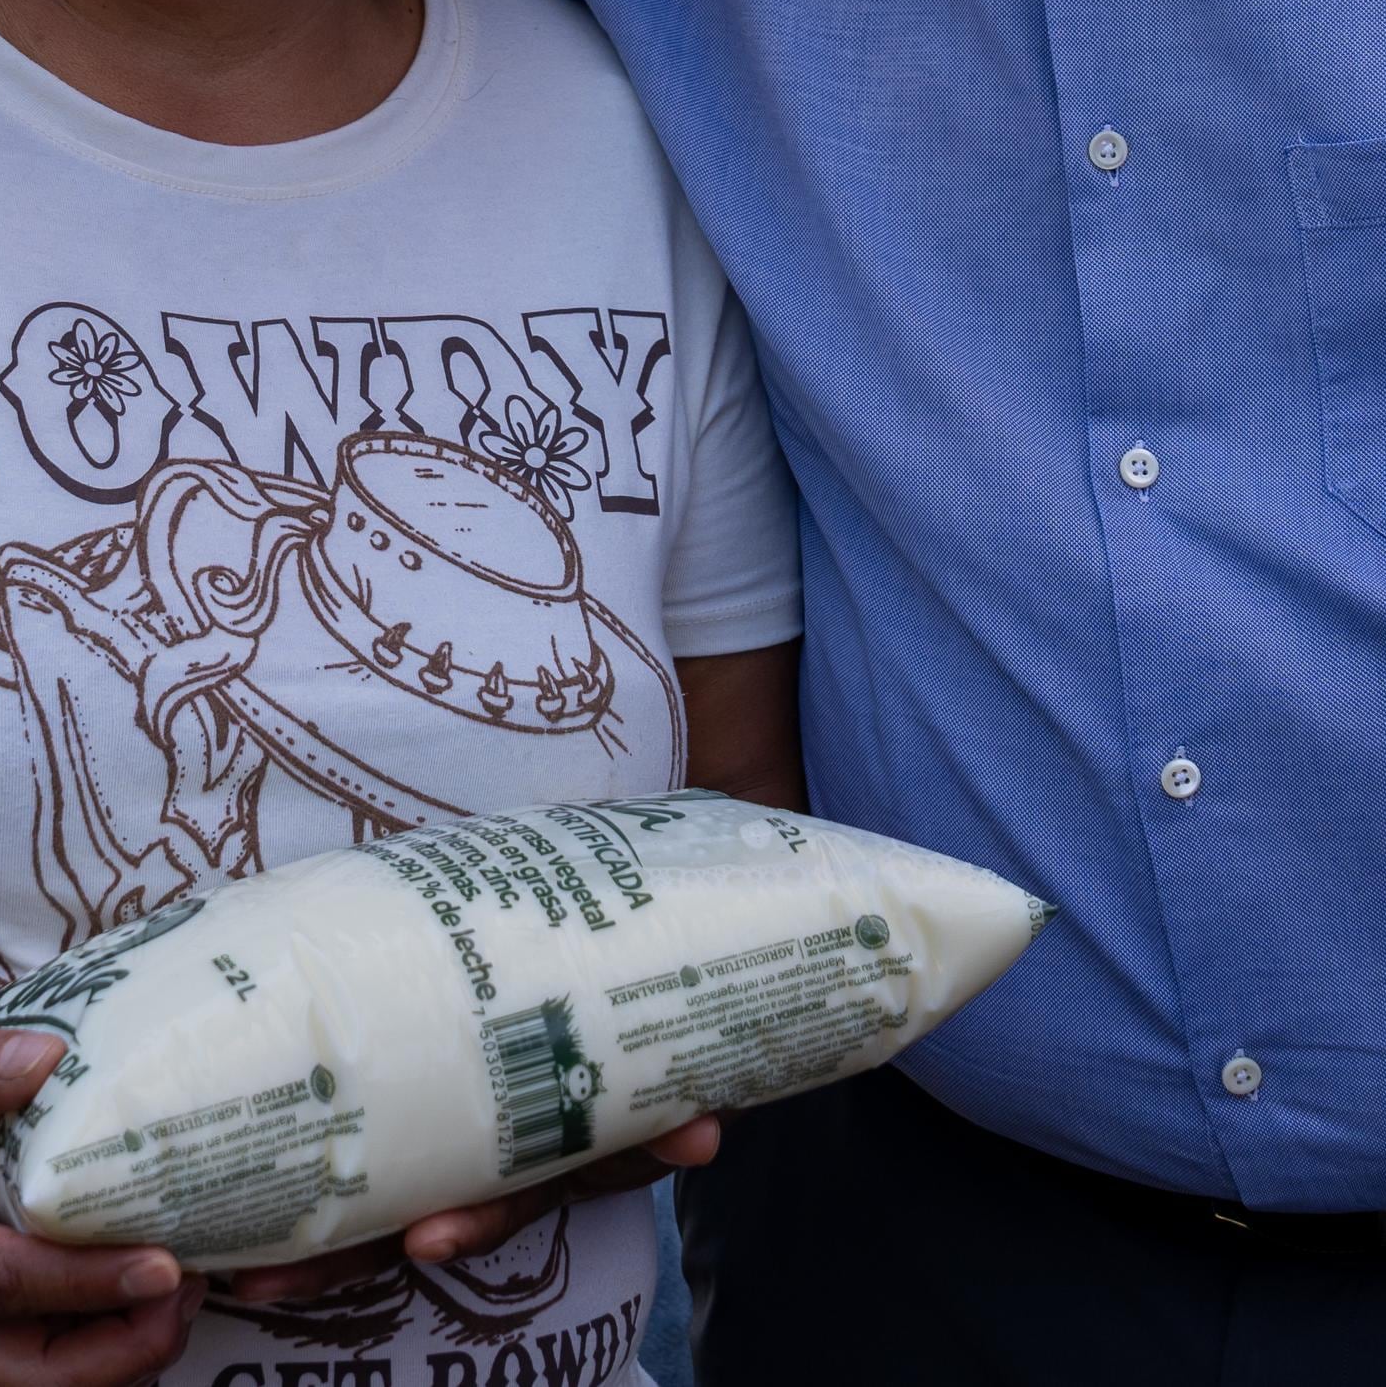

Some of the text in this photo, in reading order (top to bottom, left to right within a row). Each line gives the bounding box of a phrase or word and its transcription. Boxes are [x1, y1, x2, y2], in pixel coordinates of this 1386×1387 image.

[499, 846, 528, 866] en
[536, 806, 654, 910] FORTIFICADA
[405, 840, 482, 902] vitaminas.
[436, 832, 488, 868] hierro,
[478, 866, 521, 909] zinc,
[503, 823, 558, 856] grasa
[548, 854, 616, 931] vegetal
[416, 880, 448, 899] %
[513, 866, 568, 928] grasa,
[431, 900, 462, 927] de
[803, 926, 852, 950] MÉXICO
[449, 928, 497, 1002] leche
[705, 943, 795, 980] AGRICULTURA
[806, 948, 818, 958] DE
[776, 951, 846, 983] Manténgase
[608, 975, 681, 1006] SEGALMEX
[684, 975, 759, 1008] refrigeración
[760, 974, 775, 985] en
[765, 980, 803, 1000] distintos
[801, 980, 837, 1001] público,
[803, 974, 826, 990] fines
[744, 994, 758, 1005] los
[758, 991, 765, 1000] a
[776, 992, 802, 1008] ajeno
[675, 1013, 688, 1024] en
[688, 997, 744, 1022] establecidos
[718, 998, 827, 1038] PROHIBIDA SU REVENTA
[727, 1001, 770, 1023] cualquier
[660, 1023, 695, 1043] político
[665, 1017, 675, 1028] el
[694, 1014, 727, 1032] partido
[621, 1036, 653, 1054] queda
[652, 1034, 660, 1043] y
[471, 1005, 486, 1016] 7
[479, 1028, 508, 1103] 503023
[250, 1078, 309, 1107] MÉXICO
[146, 1101, 243, 1142] AGRICULTURA
[222, 1110, 297, 1143] Manténgase
[204, 1134, 222, 1148] en
[49, 1139, 127, 1175] SEGALMEX
